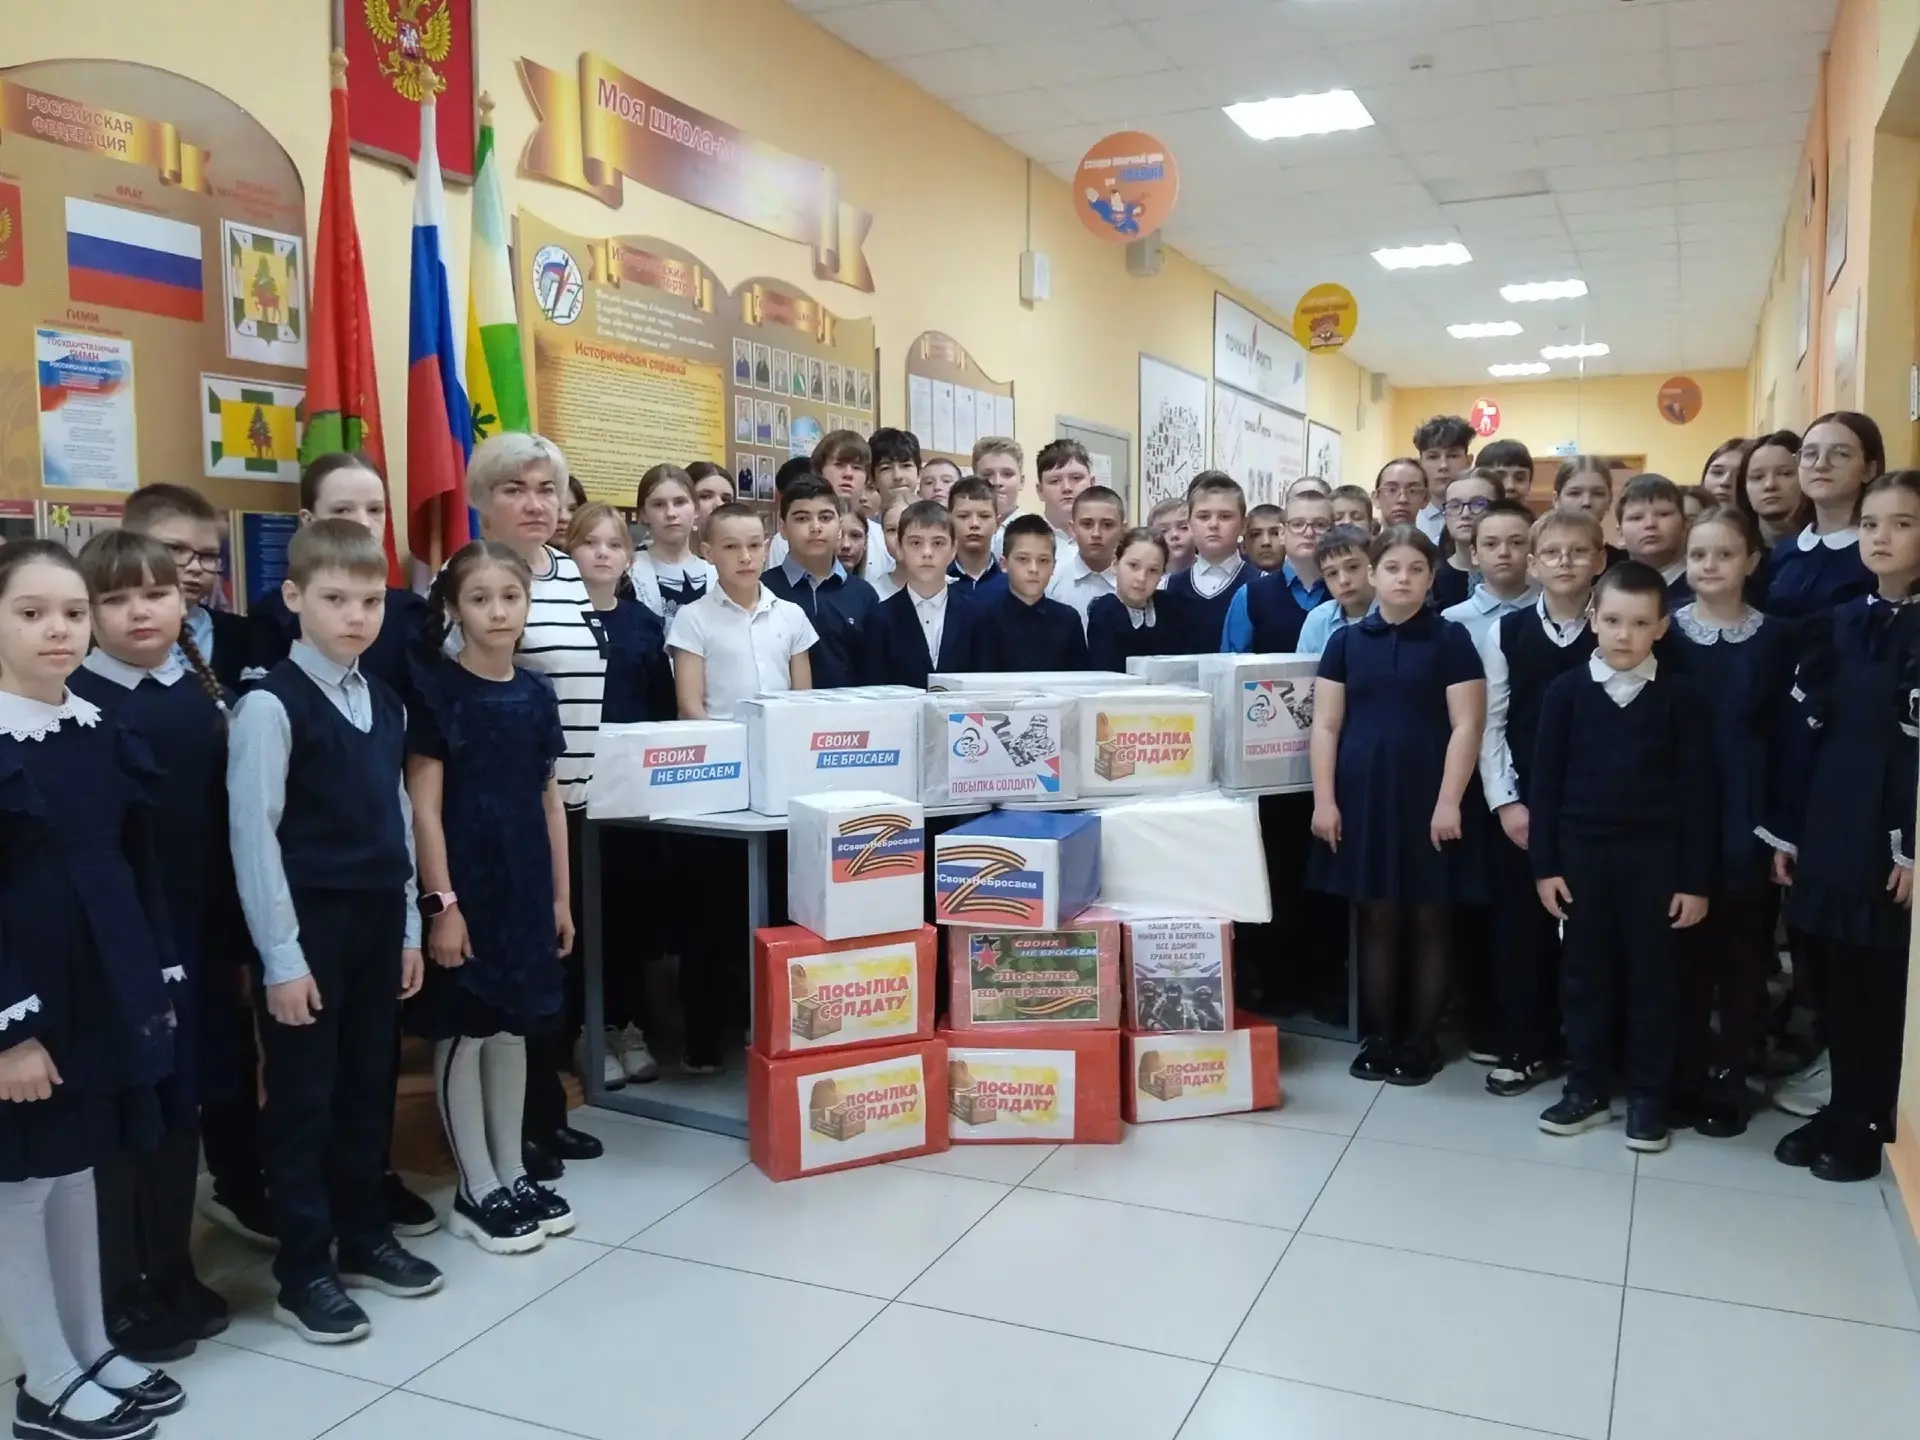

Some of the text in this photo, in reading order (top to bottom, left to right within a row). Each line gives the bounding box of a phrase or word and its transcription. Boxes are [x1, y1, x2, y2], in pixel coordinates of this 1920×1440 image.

[598, 78, 645, 126] Моя
[27, 93, 134, 135] РОССИЙСКАЯ
[32, 115, 127, 153] ФЕДЕРАЦИЯ
[66, 308, 99, 324] ГИМН
[69, 349, 99, 361] ГИМН
[575, 338, 687, 376] Историческая справка
[818, 734, 860, 748] СВОИХ
[1116, 731, 1191, 746] ПОСЫЛКА
[649, 748, 696, 764] СВОИХ
[1116, 747, 1190, 764] СОЛДАТУ
[1245, 742, 1282, 756] ПОСЫЛКА
[823, 752, 895, 766] НЕ БРОСАЕМ
[657, 765, 735, 782] НЕ БРОСАЕМ
[952, 778, 1037, 793] ПОСЫЛКА СОЛДАТУ
[1040, 948, 1098, 956] БРОСАЕМ
[818, 976, 910, 1001] ПОСЫЛКА
[976, 989, 997, 998] на
[819, 995, 908, 1019] СОЛДАТУ
[1165, 1061, 1225, 1074] ПОСЫЛКА
[1166, 1073, 1225, 1087] СОЛДАТУ
[845, 1083, 918, 1108] ПОСЫЛКА
[977, 1081, 1055, 1096] ПОСЫЛКА
[847, 1099, 918, 1123] СОЛДАТУ
[977, 1097, 1054, 1112] СОЛДАТУ
